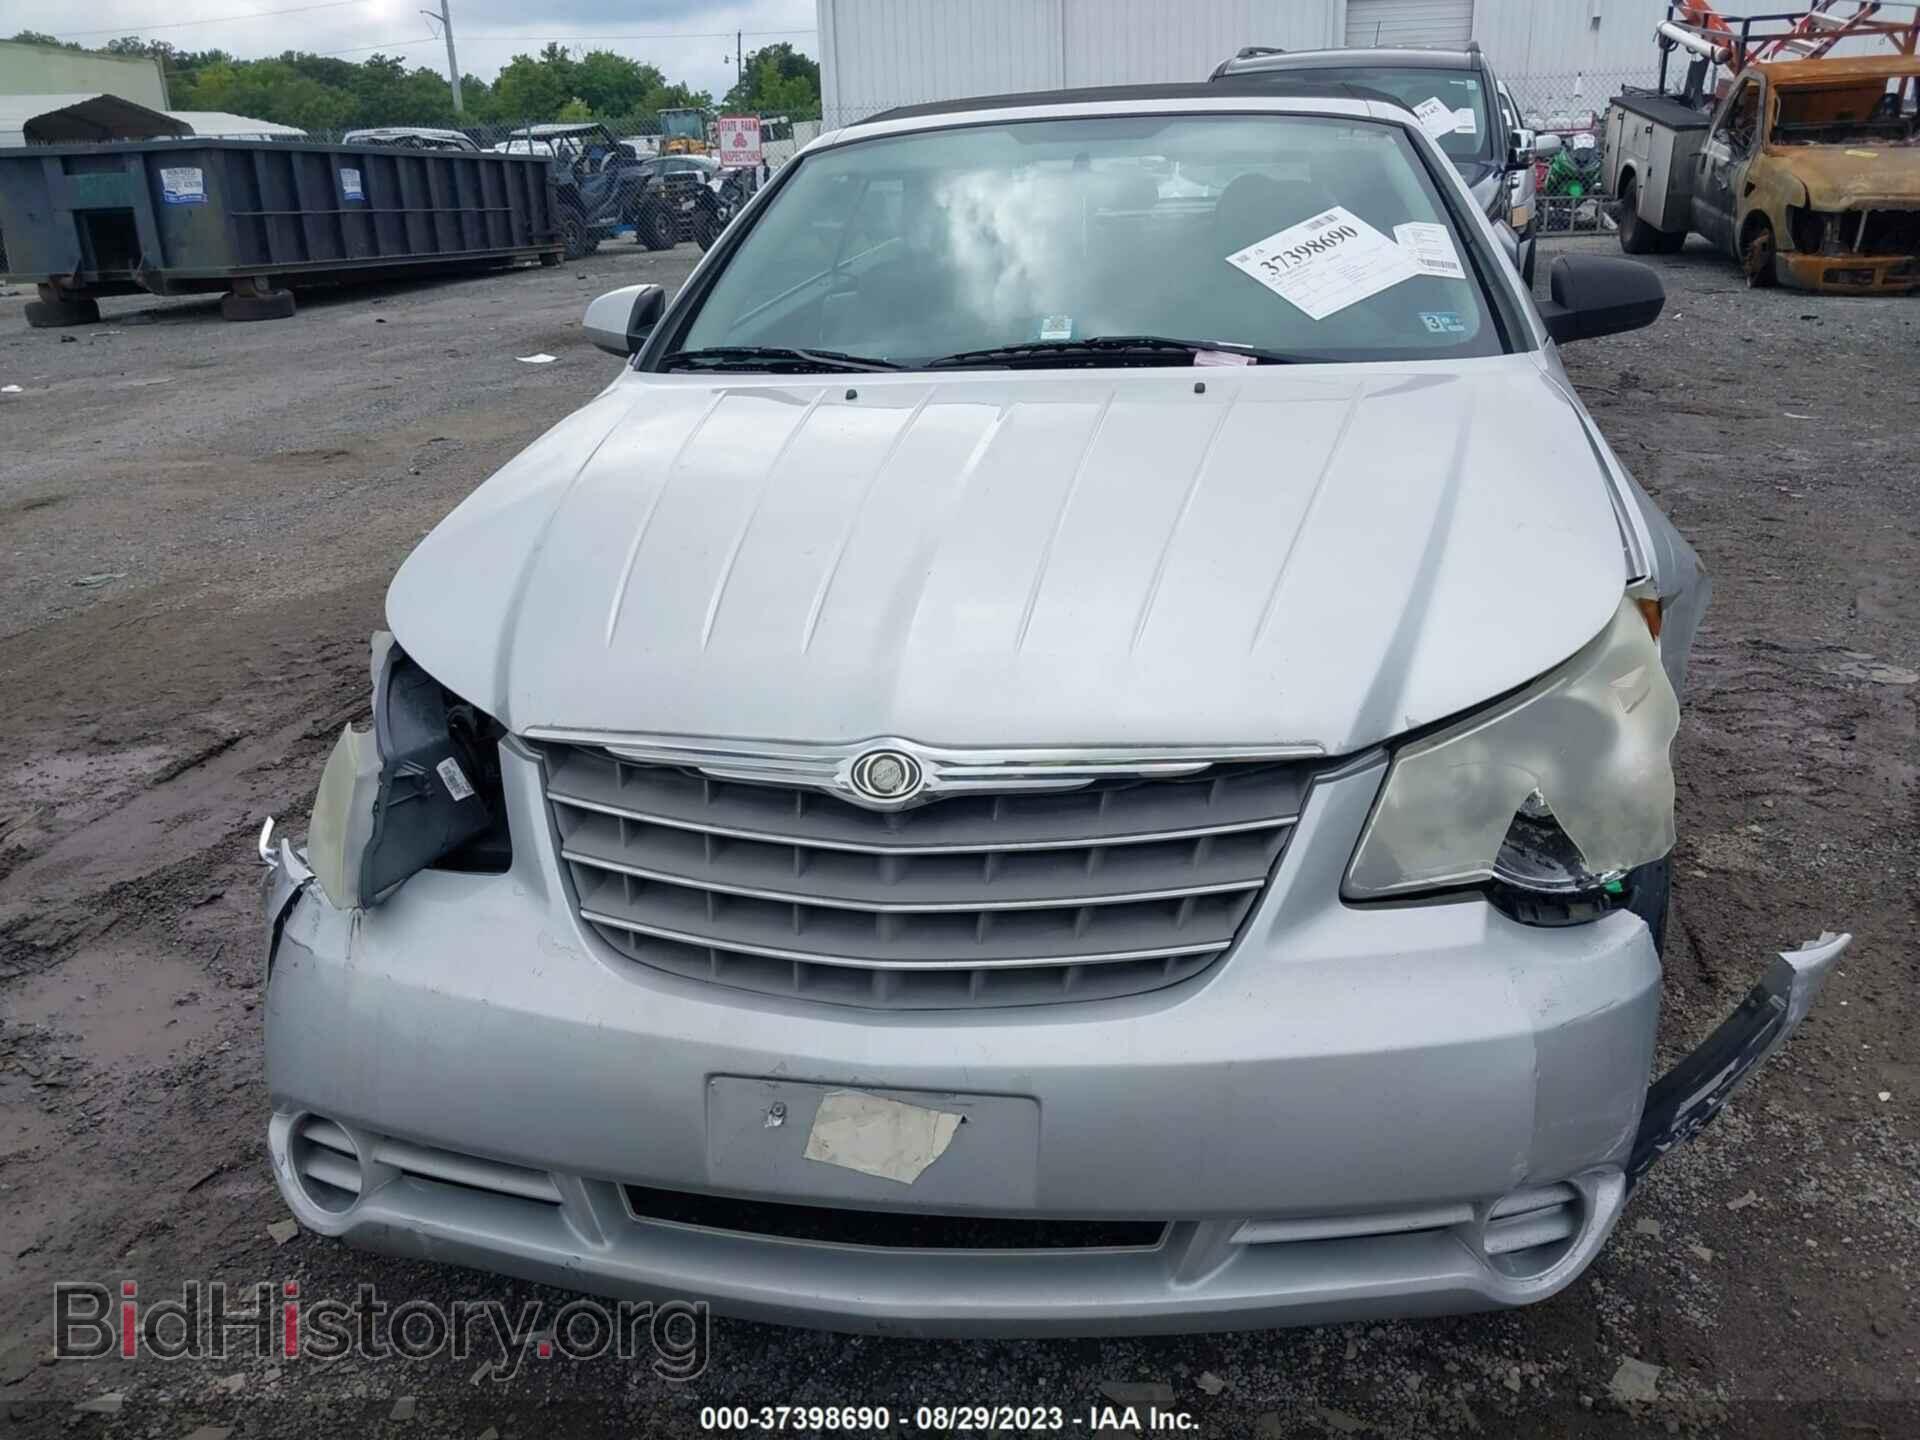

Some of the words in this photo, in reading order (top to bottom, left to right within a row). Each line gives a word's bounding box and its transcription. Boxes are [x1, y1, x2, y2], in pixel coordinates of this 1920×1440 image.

[721, 119, 737, 131] STATE
[741, 119, 758, 131] FARM
[721, 150, 761, 162] INSPECTIONS
[1260, 224, 1359, 276] 37398690
